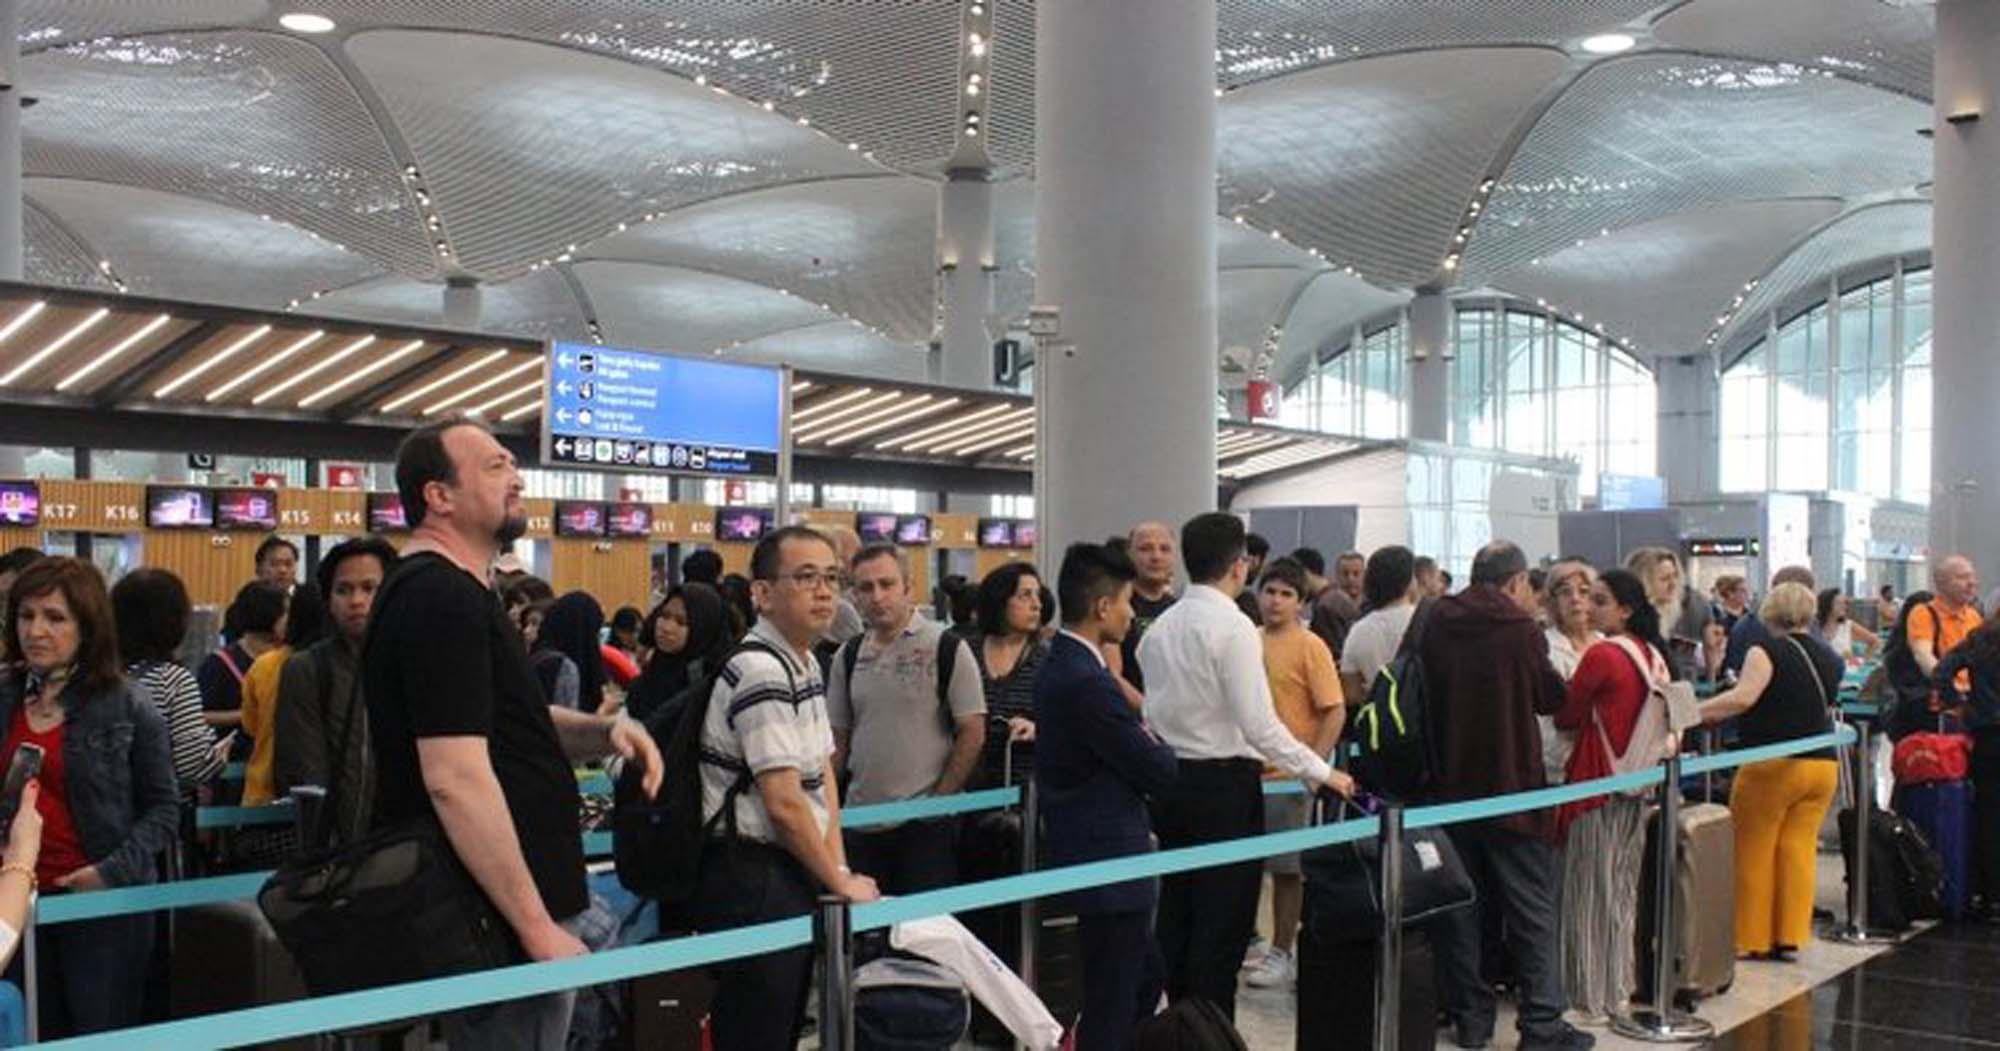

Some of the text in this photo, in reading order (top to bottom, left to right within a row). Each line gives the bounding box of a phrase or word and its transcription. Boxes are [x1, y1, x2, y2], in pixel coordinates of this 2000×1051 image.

[1000, 343, 1013, 381] J
[43, 504, 77, 519] K17
[105, 505, 139, 520] K16
[281, 510, 310, 526] K15
[334, 511, 361, 526] K14
